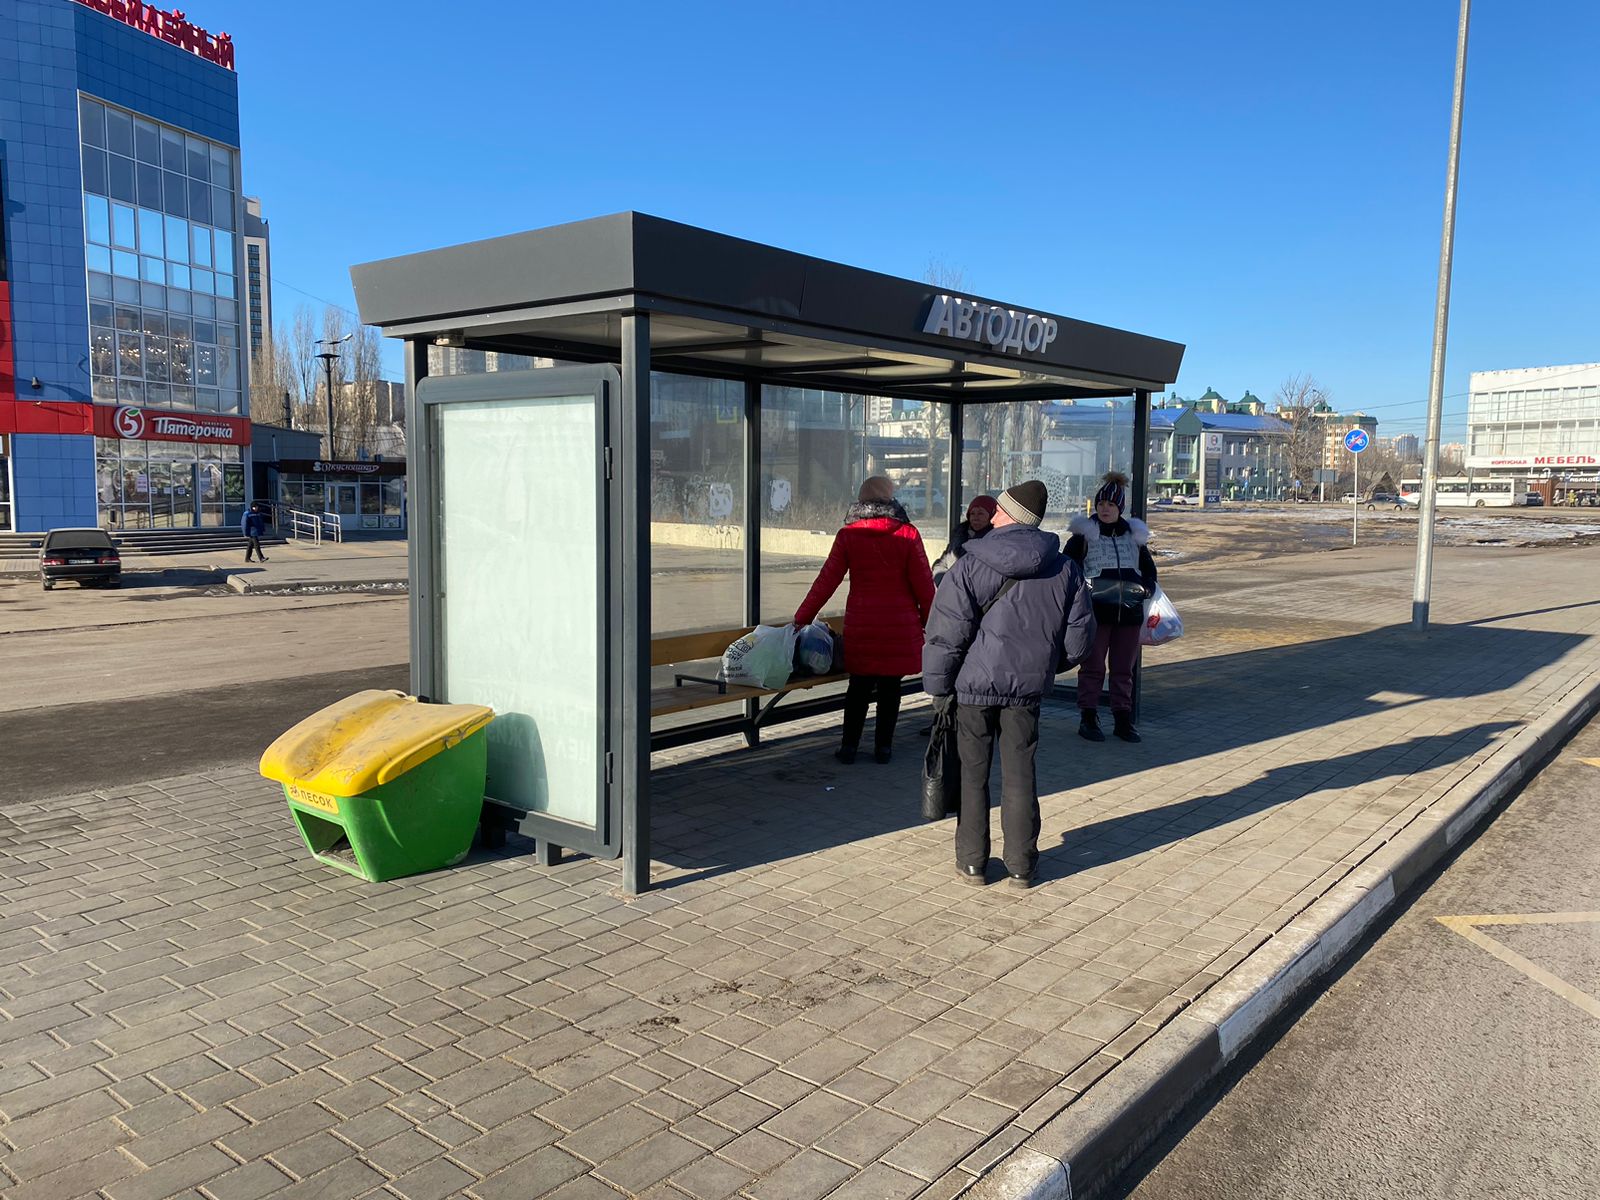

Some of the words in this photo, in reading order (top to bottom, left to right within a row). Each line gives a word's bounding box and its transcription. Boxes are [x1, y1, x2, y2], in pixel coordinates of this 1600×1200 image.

[923, 295, 1058, 355] АВТОДОР
[152, 416, 233, 440] Пятерочка
[1534, 456, 1596, 464] МЕБЕЛЬ
[300, 789, 334, 809] ПЕСОК
